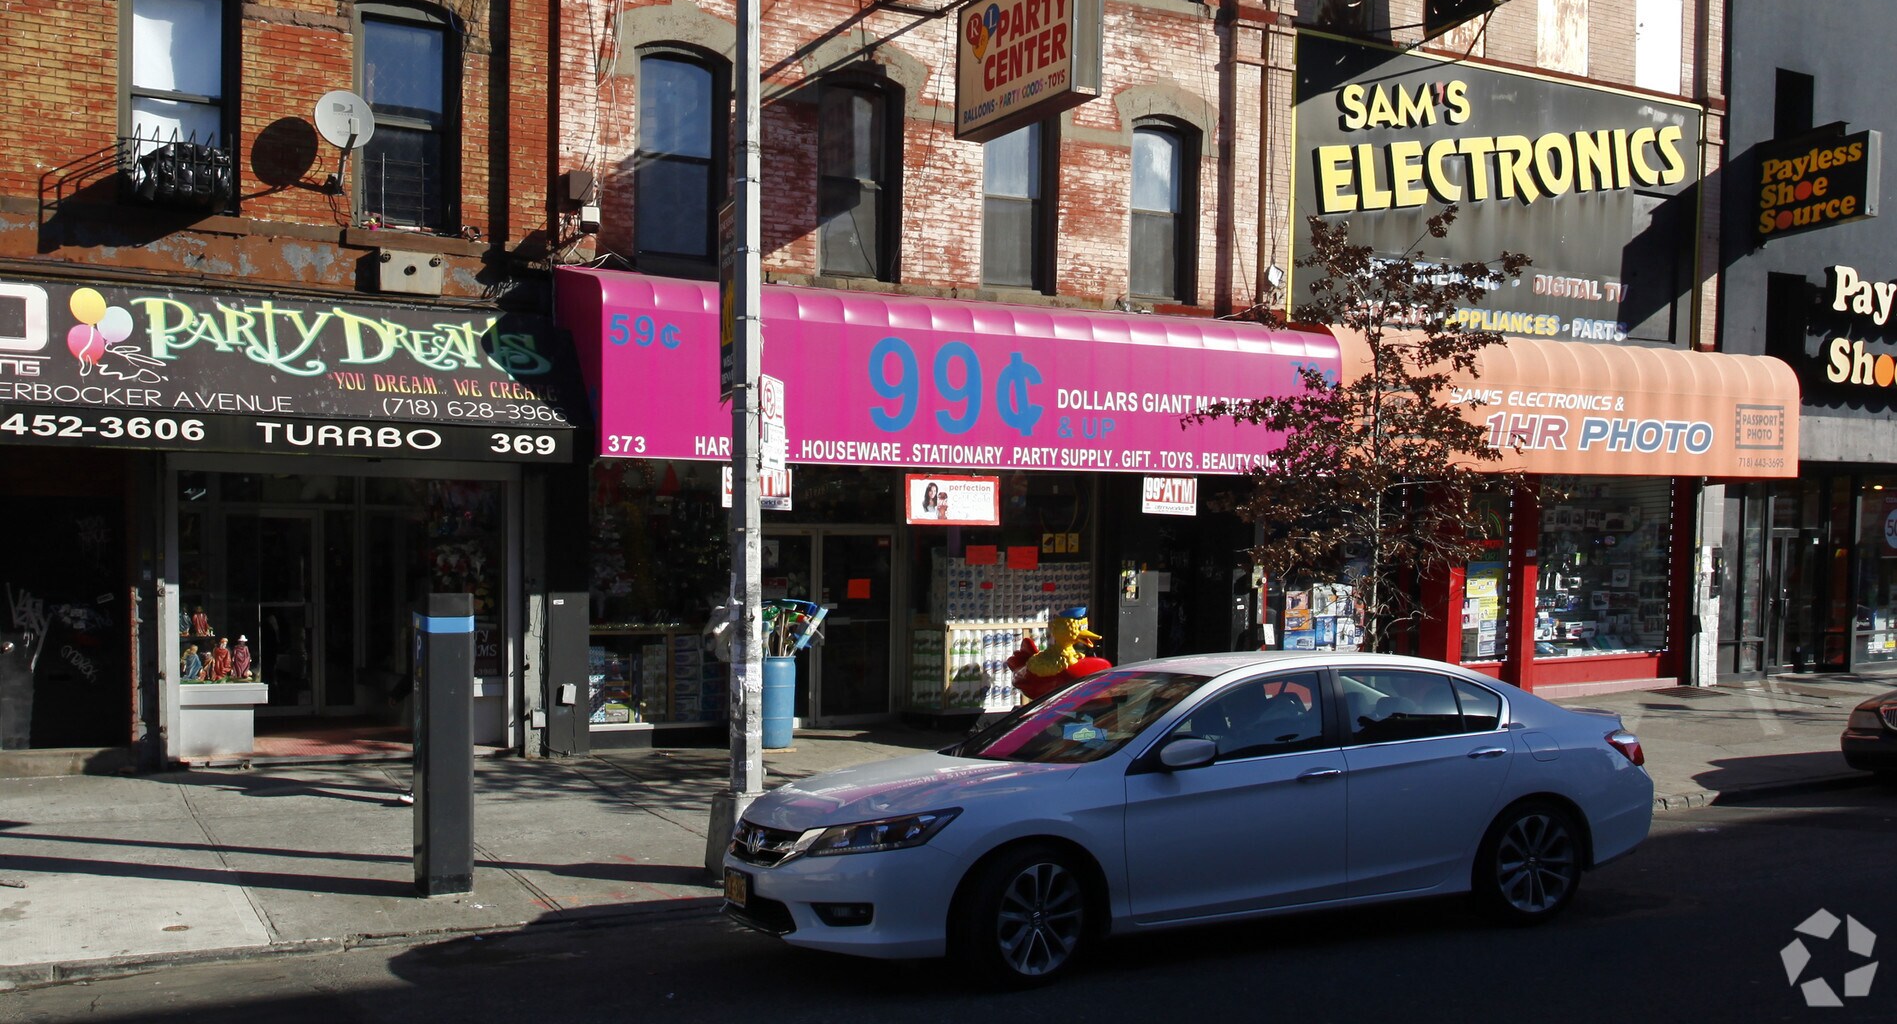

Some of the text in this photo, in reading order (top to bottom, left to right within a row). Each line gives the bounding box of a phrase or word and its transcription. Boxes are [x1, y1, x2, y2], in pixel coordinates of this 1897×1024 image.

[983, 22, 1067, 93] CENTER
[1048, 69, 1065, 88] TOYS
[1341, 80, 1471, 130] SAM'S
[1316, 126, 1686, 214] ELECTRONICS
[1761, 141, 1863, 185] Payless
[1760, 176, 1828, 209] Shoe
[1758, 194, 1857, 234] Source
[1533, 274, 1602, 301] DIGITAL
[1604, 282, 1628, 303] TV
[129, 295, 334, 376] PARTY
[1445, 307, 1560, 336] APPLIANCES
[1571, 317, 1628, 342] PARTS
[453, 378, 482, 398] WE
[1057, 388, 1138, 412] DOLLARS
[1142, 393, 1192, 414] GIANT
[1450, 387, 1625, 412] SAM'S ELECTRONICS &
[173, 391, 294, 413] AVENUE
[382, 397, 568, 423] (718) 628-3966
[0, 413, 205, 441] 452-3606
[1081, 417, 1116, 440] UP
[1742, 414, 1778, 426] PASSPORT
[490, 433, 556, 455] 369
[608, 434, 646, 453] 373
[1578, 418, 1714, 455] PHOTO
[1747, 428, 1773, 440] PHOTO
[802, 440, 901, 462] HOUSEWARE
[912, 443, 1003, 465] STATIONARY
[1013, 446, 1059, 466] PARTY
[1061, 448, 1113, 467] SUPPLY
[1121, 450, 1151, 468] GIFT
[1160, 451, 1194, 469] TOYS
[1202, 452, 1251, 470] BEAUTY
[949, 483, 991, 493] perfection
